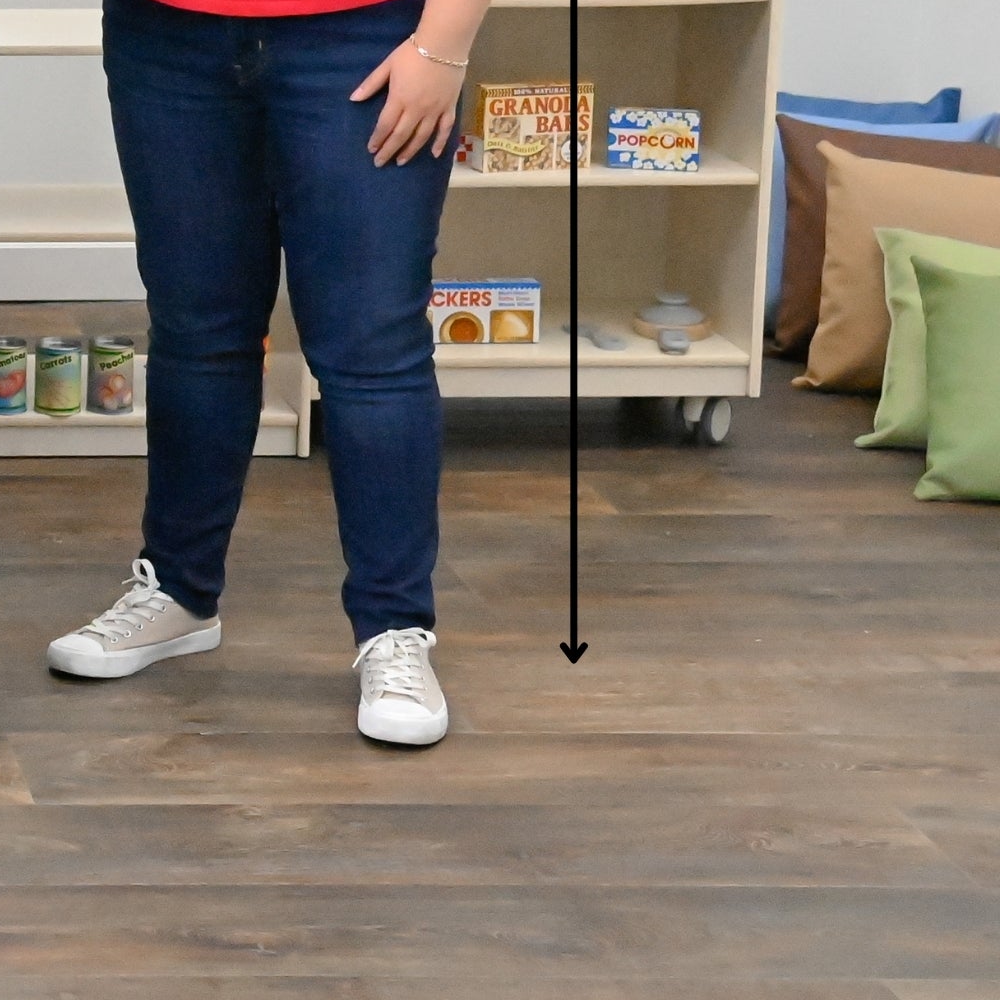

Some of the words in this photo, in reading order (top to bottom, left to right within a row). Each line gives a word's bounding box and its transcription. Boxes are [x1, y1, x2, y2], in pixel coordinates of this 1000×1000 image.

[534, 86, 568, 95] NATURAL
[618, 134, 695, 149] POPCORN
[429, 291, 492, 307] CKERS
[39, 353, 73, 371] Carrots
